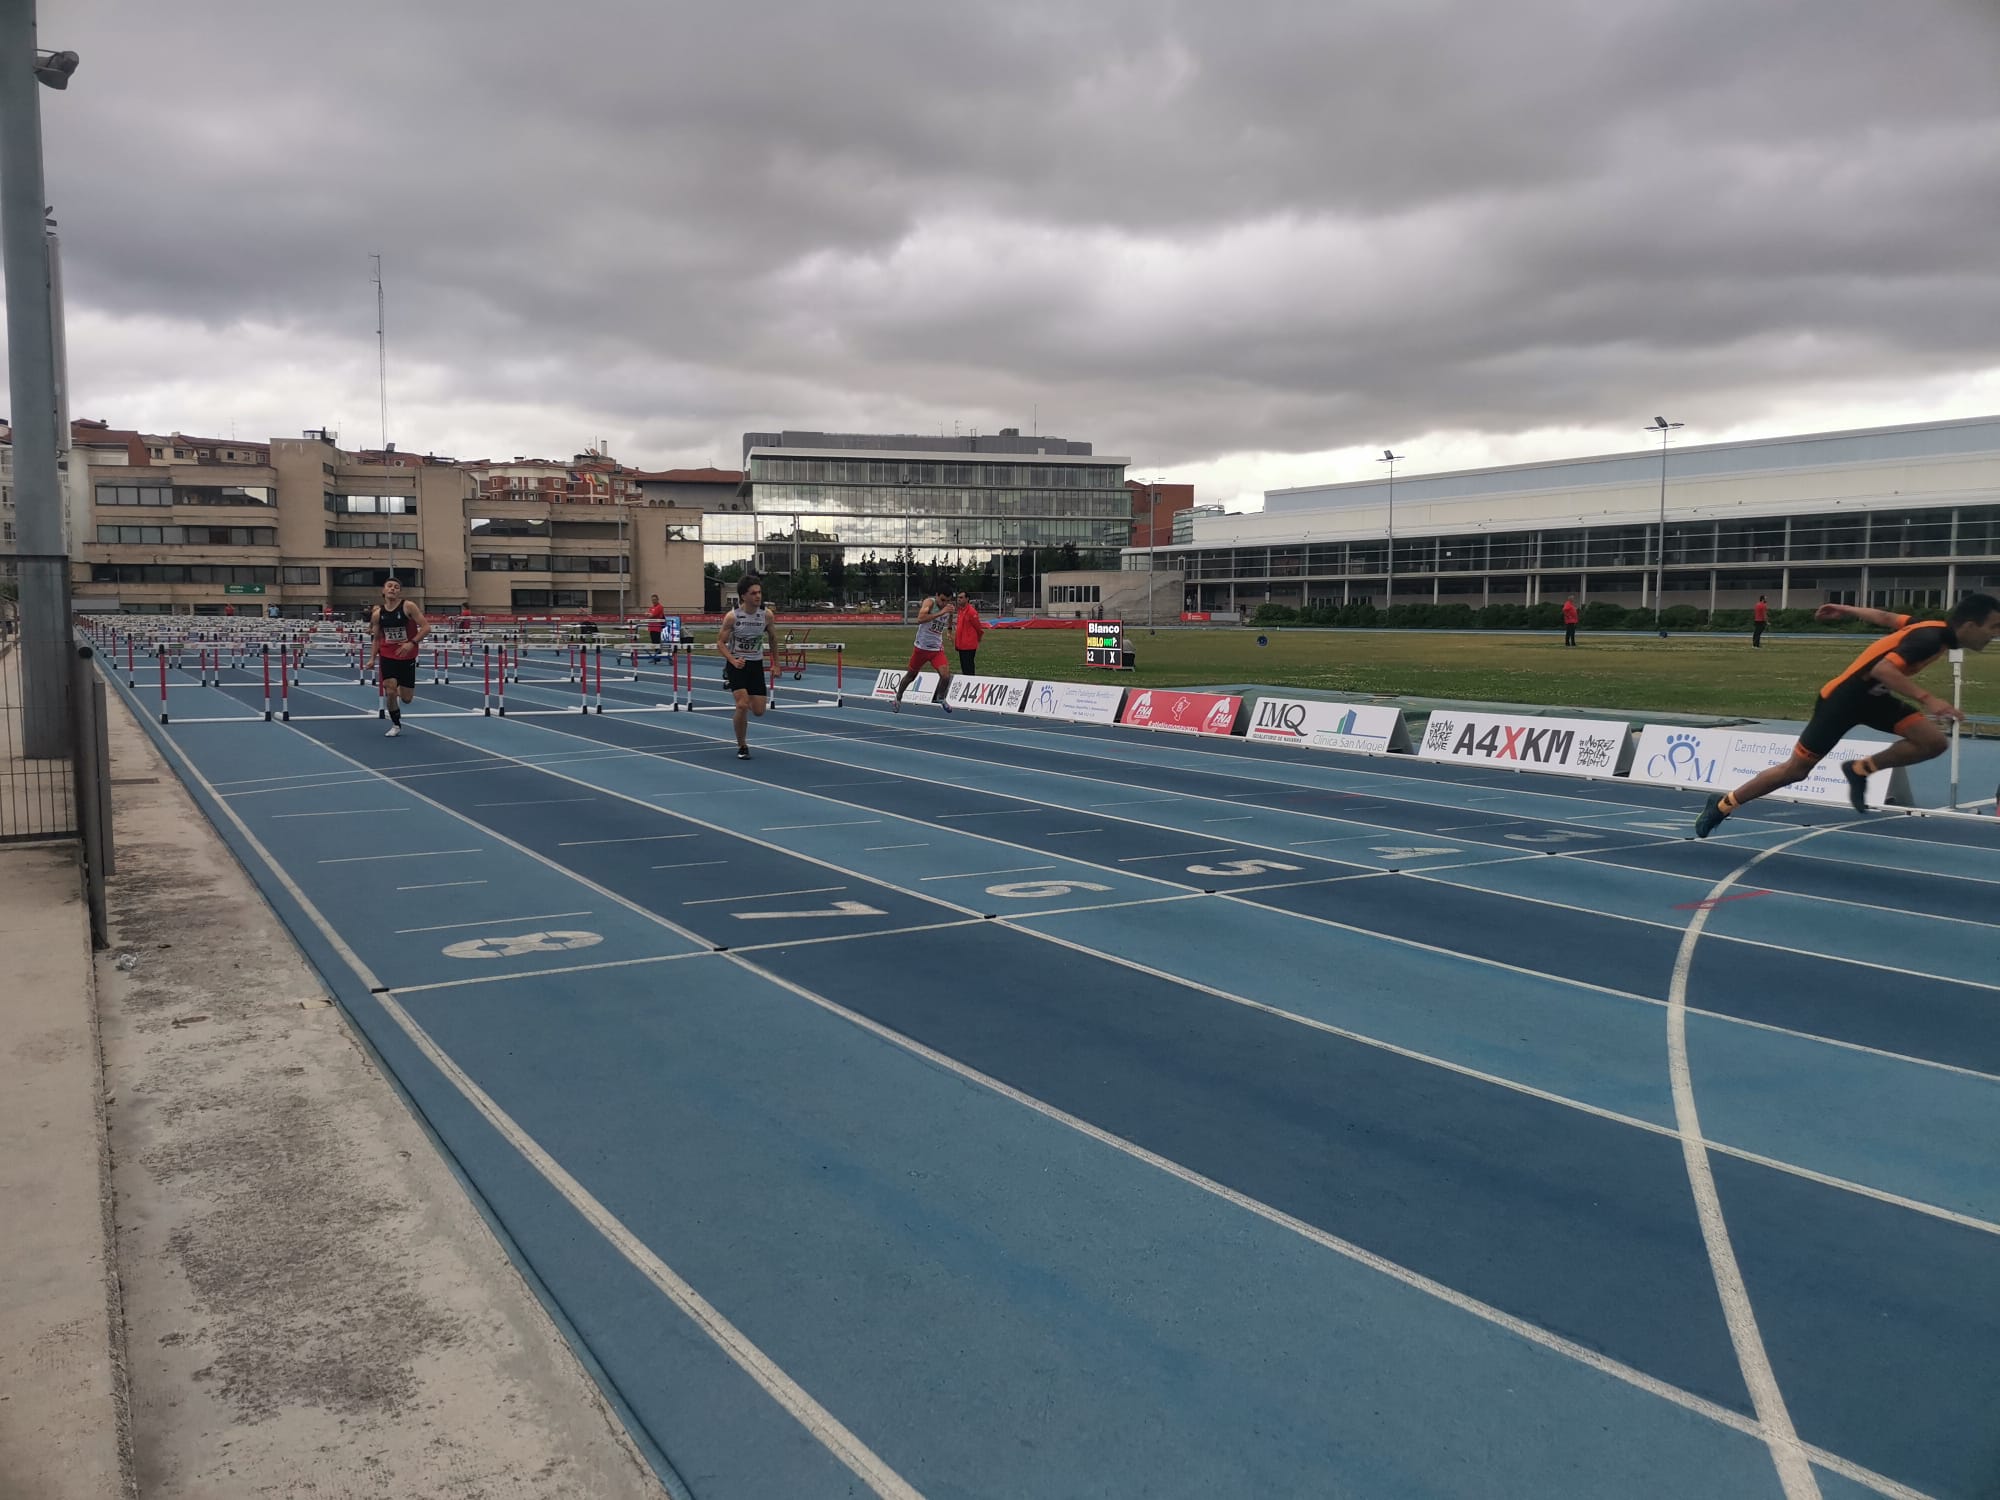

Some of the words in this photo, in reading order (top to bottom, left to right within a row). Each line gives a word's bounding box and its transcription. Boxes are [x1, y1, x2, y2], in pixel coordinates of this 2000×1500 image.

[388, 631, 404, 640] 212
[1088, 622, 1120, 634] Blanco
[1109, 651, 1115, 664] X
[876, 671, 901, 693] IMQ
[958, 681, 1009, 706] A4XKM
[1136, 706, 1153, 717] FNA
[1213, 713, 1233, 724] FNA
[1256, 701, 1308, 737] IMQ
[1338, 737, 1355, 749] San
[1354, 739, 1387, 753] Miguel
[1452, 722, 1576, 765] A4XKM
[1735, 739, 1766, 754] Centro
[1769, 742, 1793, 756] Podo
[1795, 785, 1809, 793] 412
[1811, 786, 1825, 794] 115
[1367, 845, 1466, 861] 4
[1185, 859, 1305, 876] 5
[984, 880, 1116, 898] 6
[730, 901, 889, 920] 7
[441, 930, 605, 959] 8
